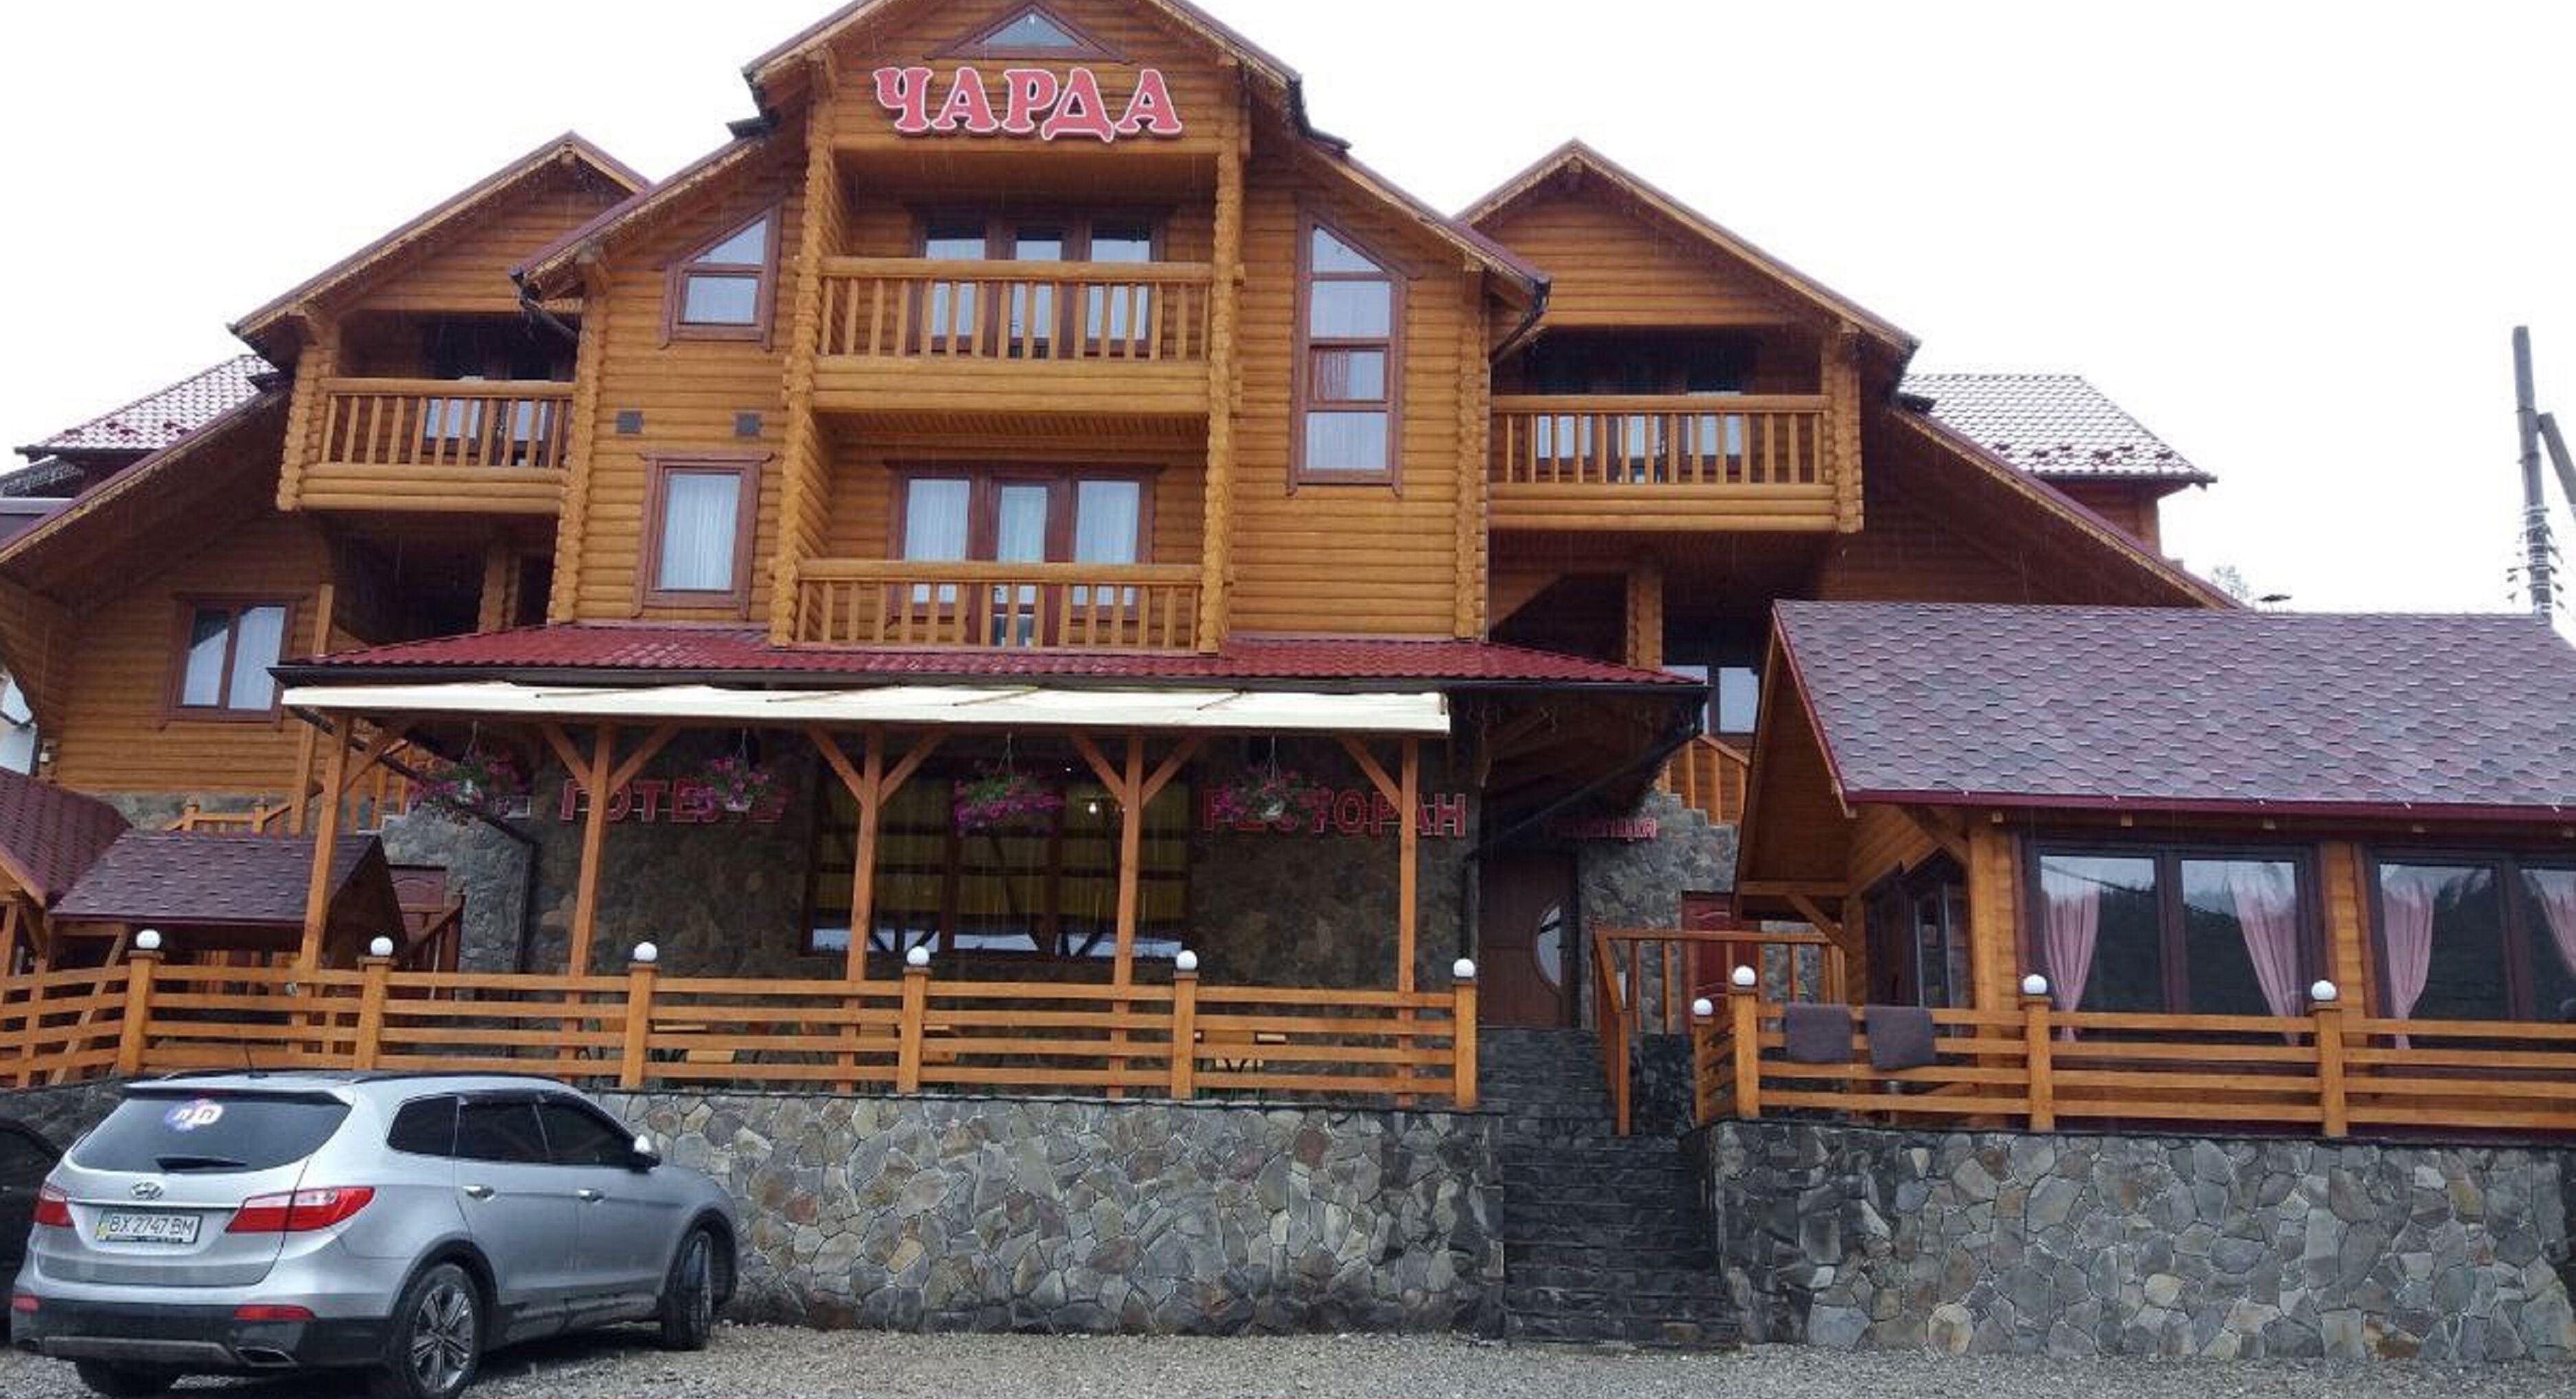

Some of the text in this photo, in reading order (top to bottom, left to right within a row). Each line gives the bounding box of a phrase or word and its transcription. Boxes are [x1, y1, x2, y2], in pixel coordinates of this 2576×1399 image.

[873, 67, 1182, 142] ЧАРДА
[559, 778, 793, 823] ГОТЕ
[1202, 788, 1466, 836] РТОРН
